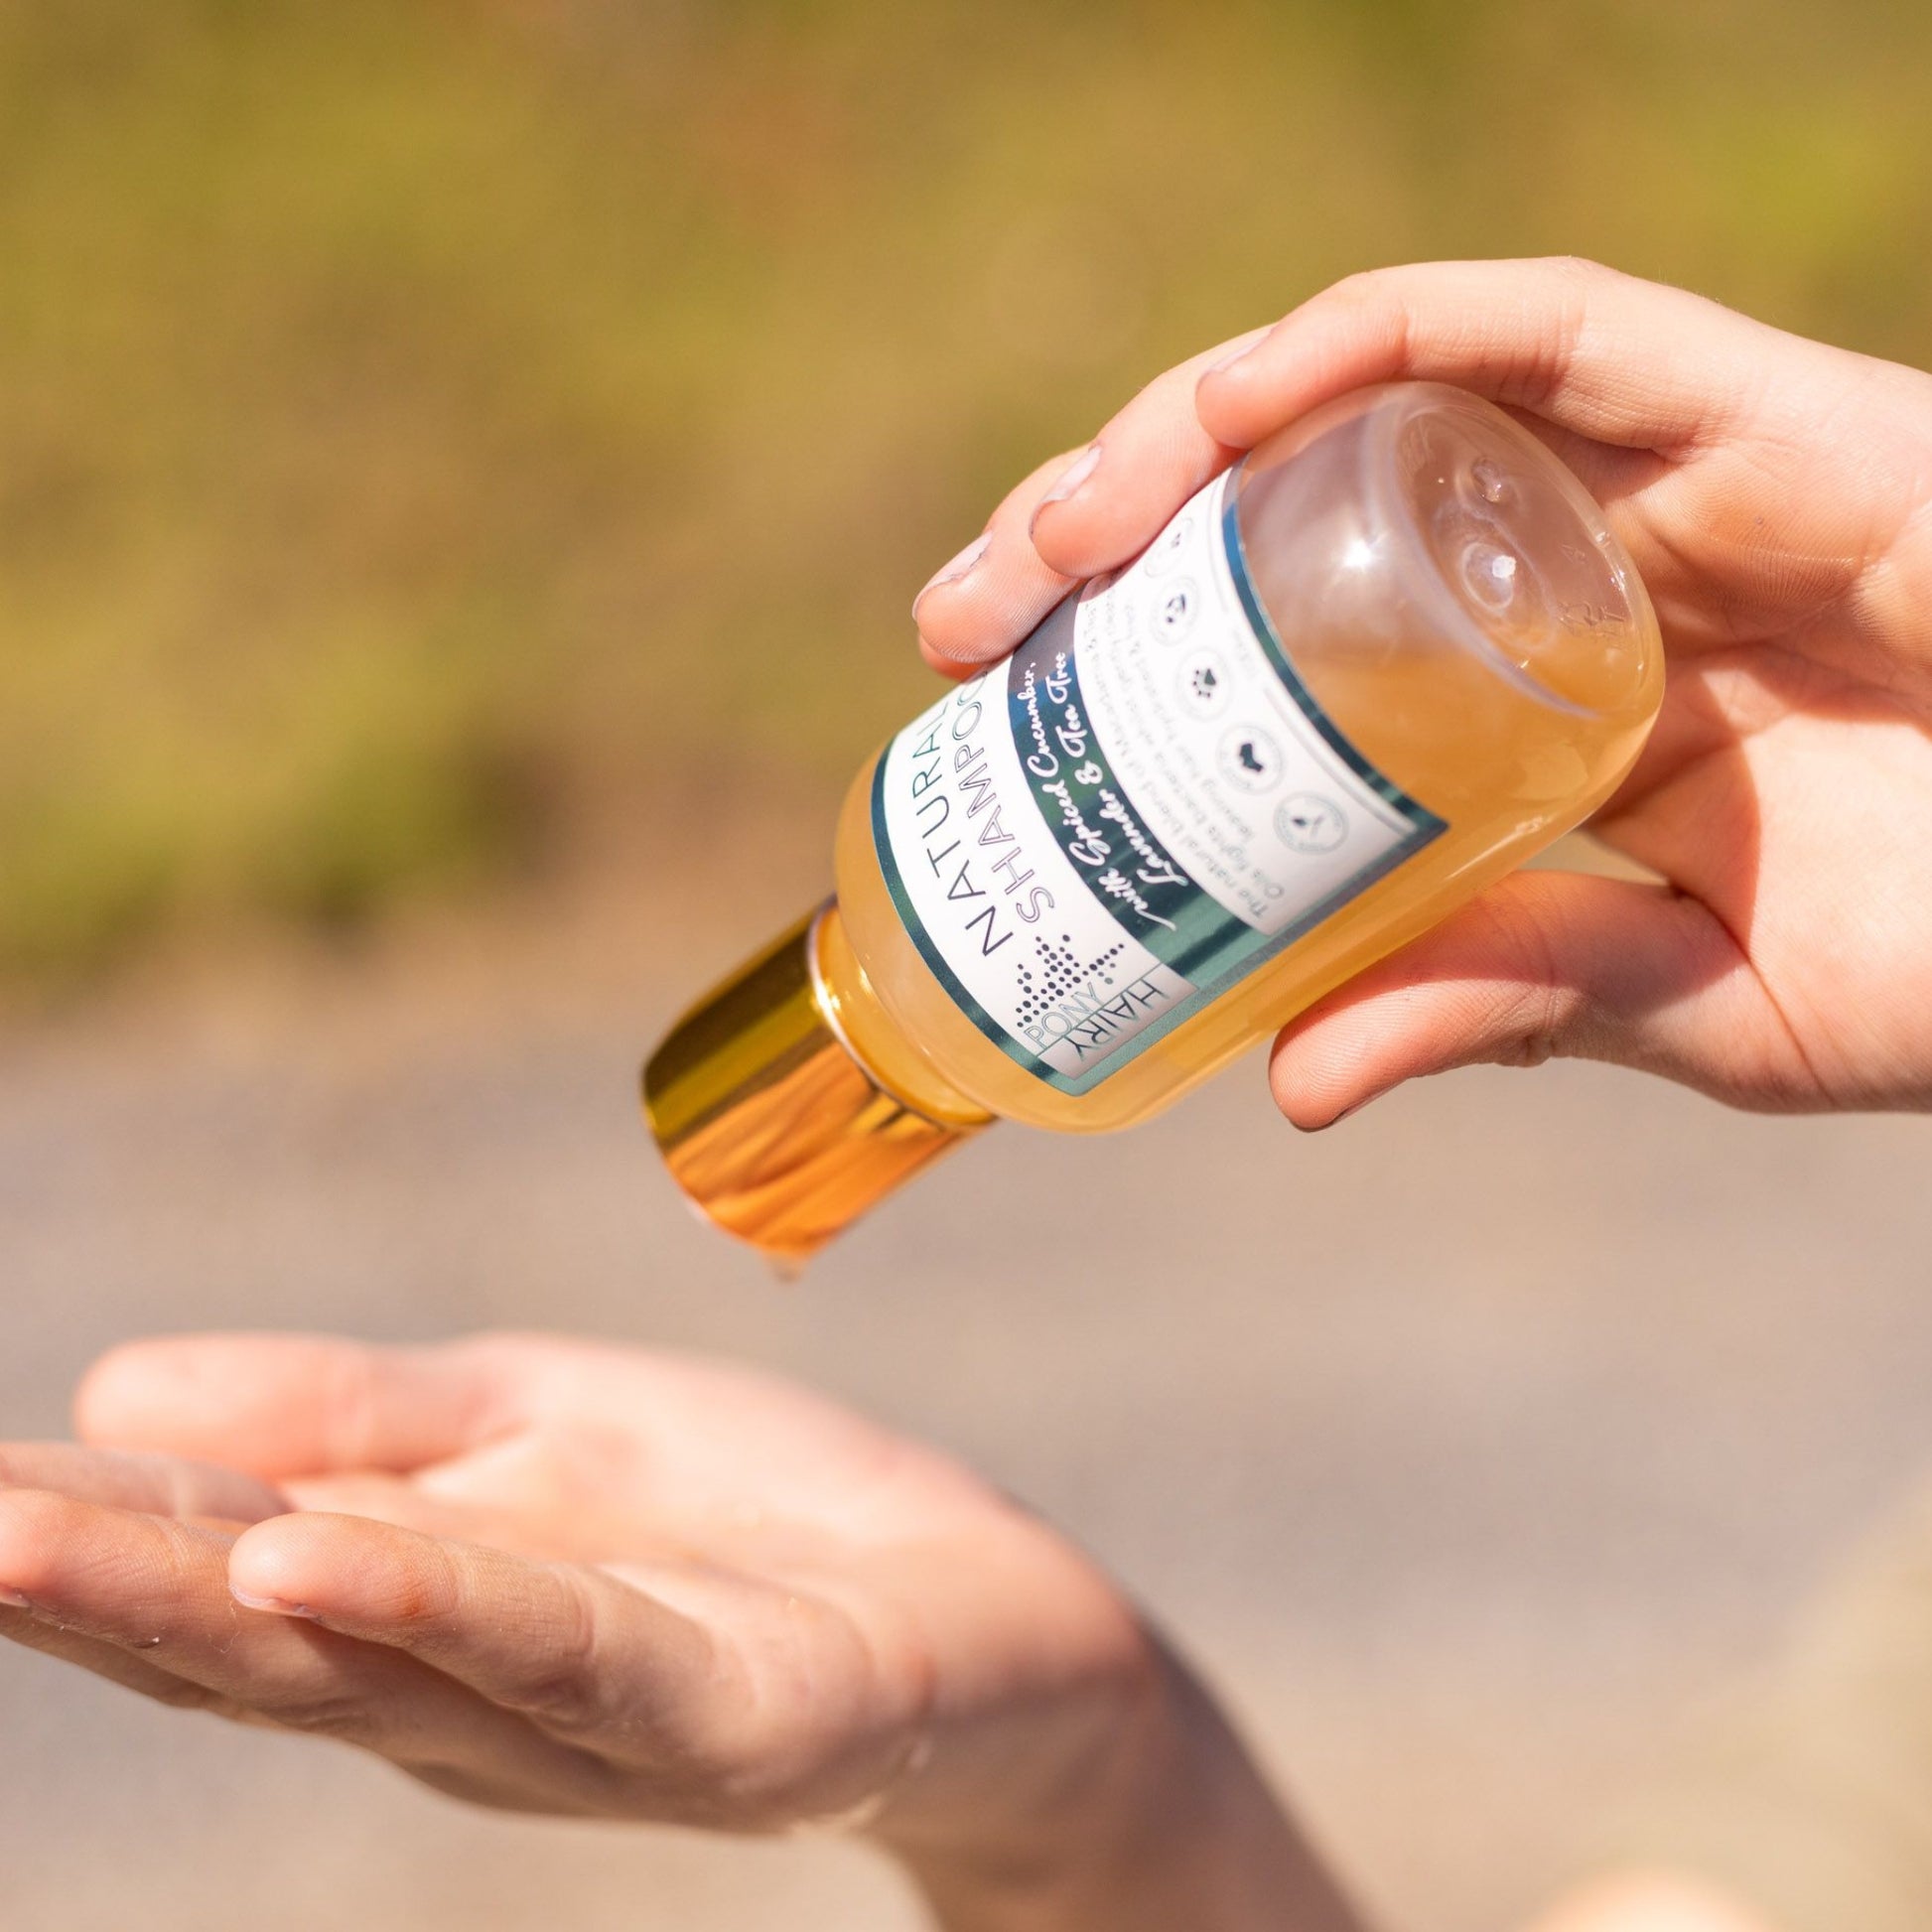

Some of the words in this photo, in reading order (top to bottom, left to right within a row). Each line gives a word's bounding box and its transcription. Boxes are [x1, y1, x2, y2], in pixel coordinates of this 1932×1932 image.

[1044, 651, 1072, 705] Tree
[1017, 662, 1059, 778] Cucumber,
[1055, 704, 1088, 759] Tea
[951, 671, 1055, 923] SHAMPOO
[1074, 759, 1103, 785] &
[912, 701, 1014, 957] NATURAL
[1041, 779, 1111, 867] Spiced
[1099, 788, 1189, 887] Lavender
[1179, 836, 1238, 889] natural
[1098, 868, 1176, 931] with
[1237, 889, 1269, 917] The
[1024, 981, 1105, 1050] PONY
[1063, 978, 1171, 1061] HAIRY
